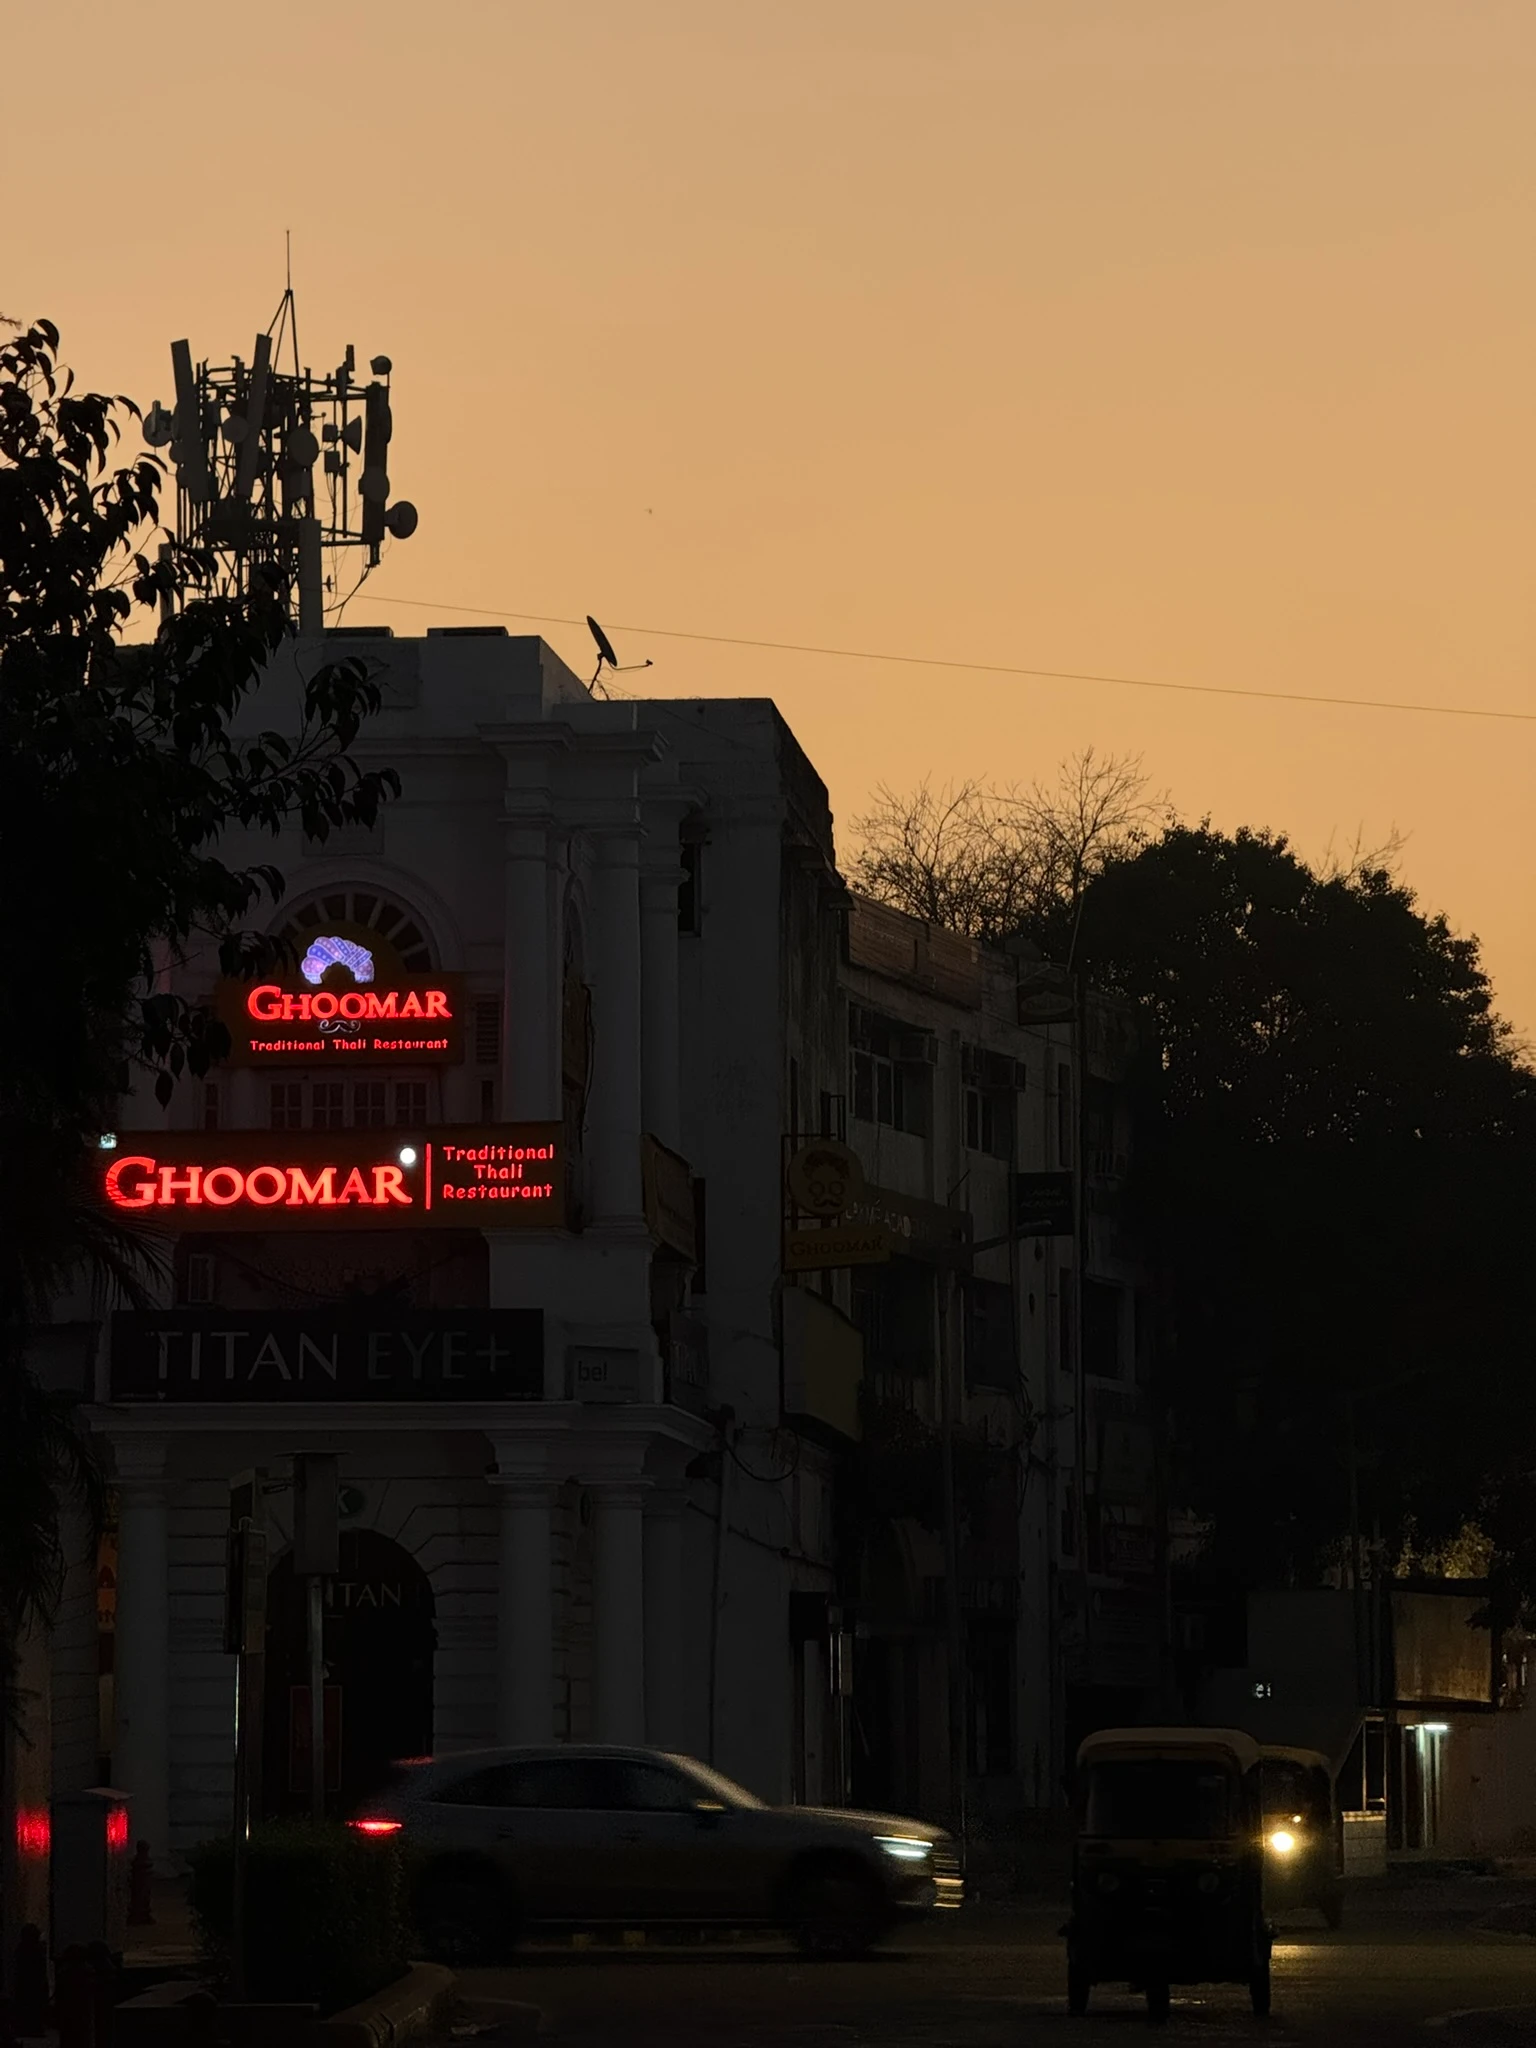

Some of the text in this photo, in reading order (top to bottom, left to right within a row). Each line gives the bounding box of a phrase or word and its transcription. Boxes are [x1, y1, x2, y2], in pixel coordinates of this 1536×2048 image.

[247, 984, 453, 1021] GHOOMAR
[250, 1038, 449, 1051] Traditional Thali Restaurant
[443, 1144, 555, 1161] Traditional
[105, 1155, 414, 1208] GHOOMAR
[473, 1163, 523, 1179] Thali
[443, 1183, 553, 1199] Restaurant
[790, 1234, 883, 1257] GHOOMAR
[145, 1331, 511, 1381] TITAN EYE+
[325, 1580, 402, 1609] ITAN
